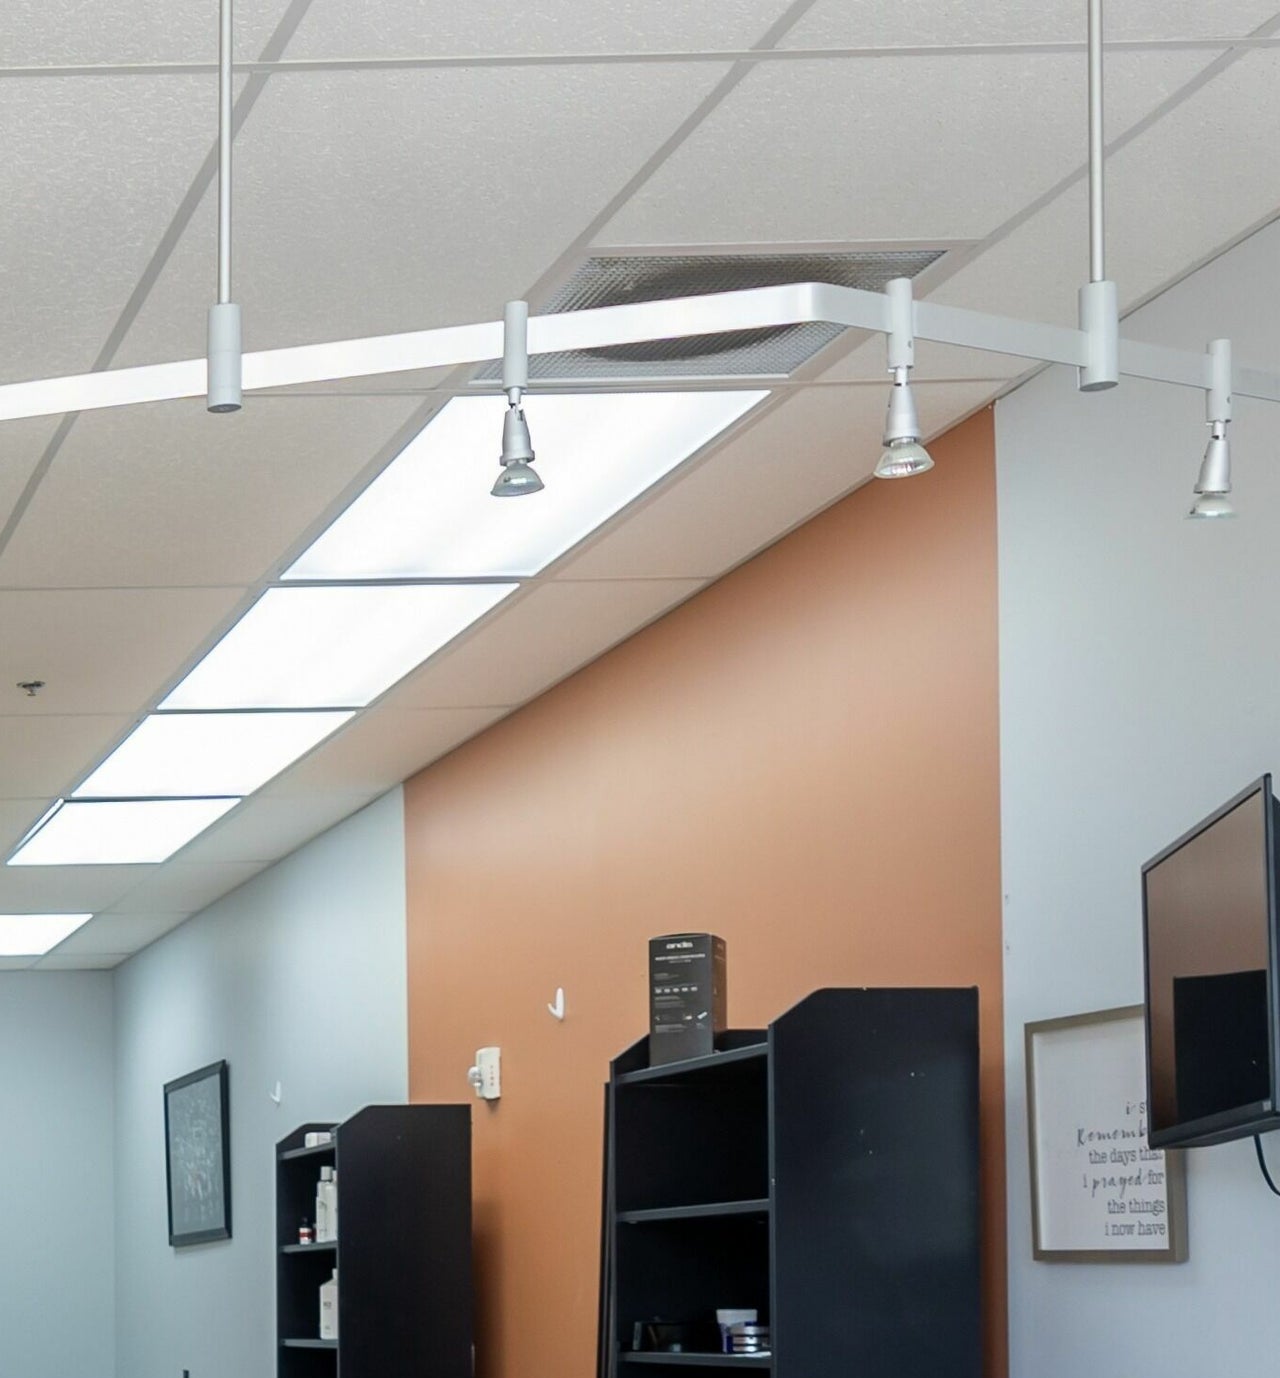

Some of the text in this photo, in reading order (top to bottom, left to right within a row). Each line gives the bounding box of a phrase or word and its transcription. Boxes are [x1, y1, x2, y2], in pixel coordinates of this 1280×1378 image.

[1089, 1150, 1107, 1164] the
[1110, 1149, 1137, 1167] days
[1091, 1167, 1143, 1199] prayed
[1147, 1169, 1165, 1185] for
[1107, 1198, 1166, 1217] the things
[1111, 1223, 1135, 1237] now
[1137, 1220, 1166, 1236] have
